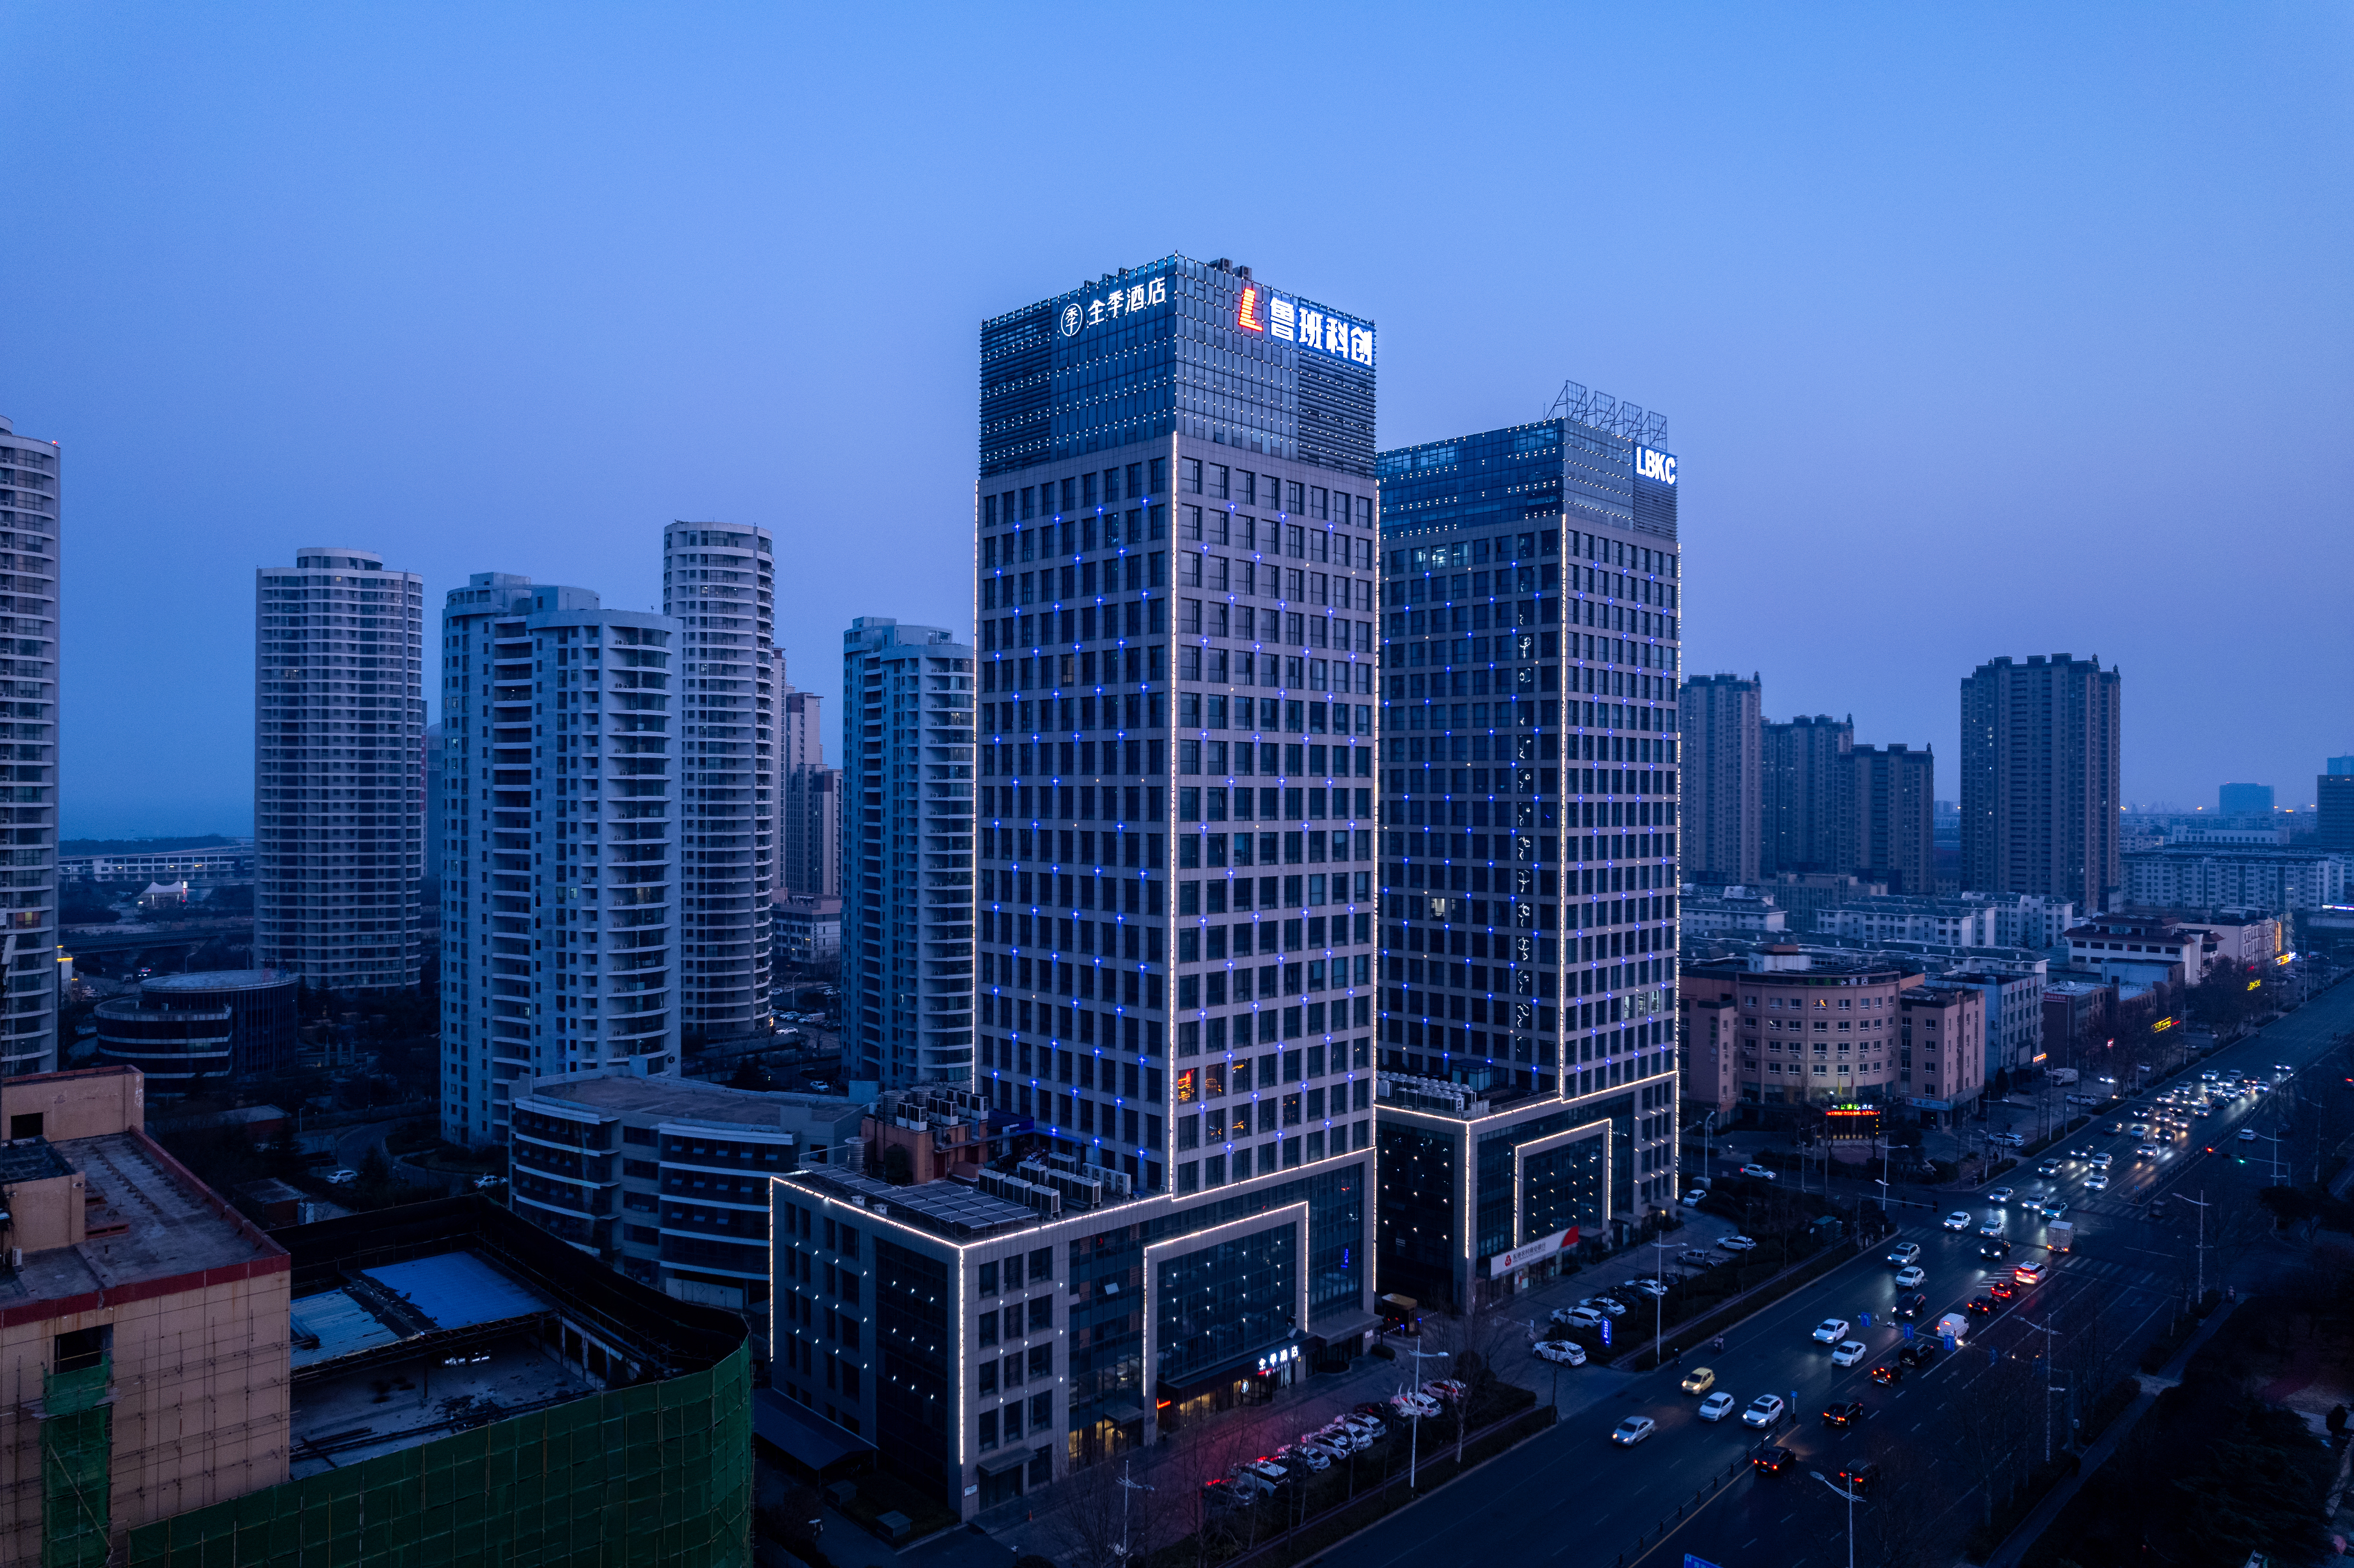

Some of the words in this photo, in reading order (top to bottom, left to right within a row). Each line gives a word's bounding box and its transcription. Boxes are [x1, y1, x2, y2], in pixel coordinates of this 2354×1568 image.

[1065, 306, 1079, 335] 季
[1088, 277, 1165, 325] 全季酒店
[1270, 296, 1372, 366] 鲁班科创
[1636, 446, 1676, 485] LBKC
